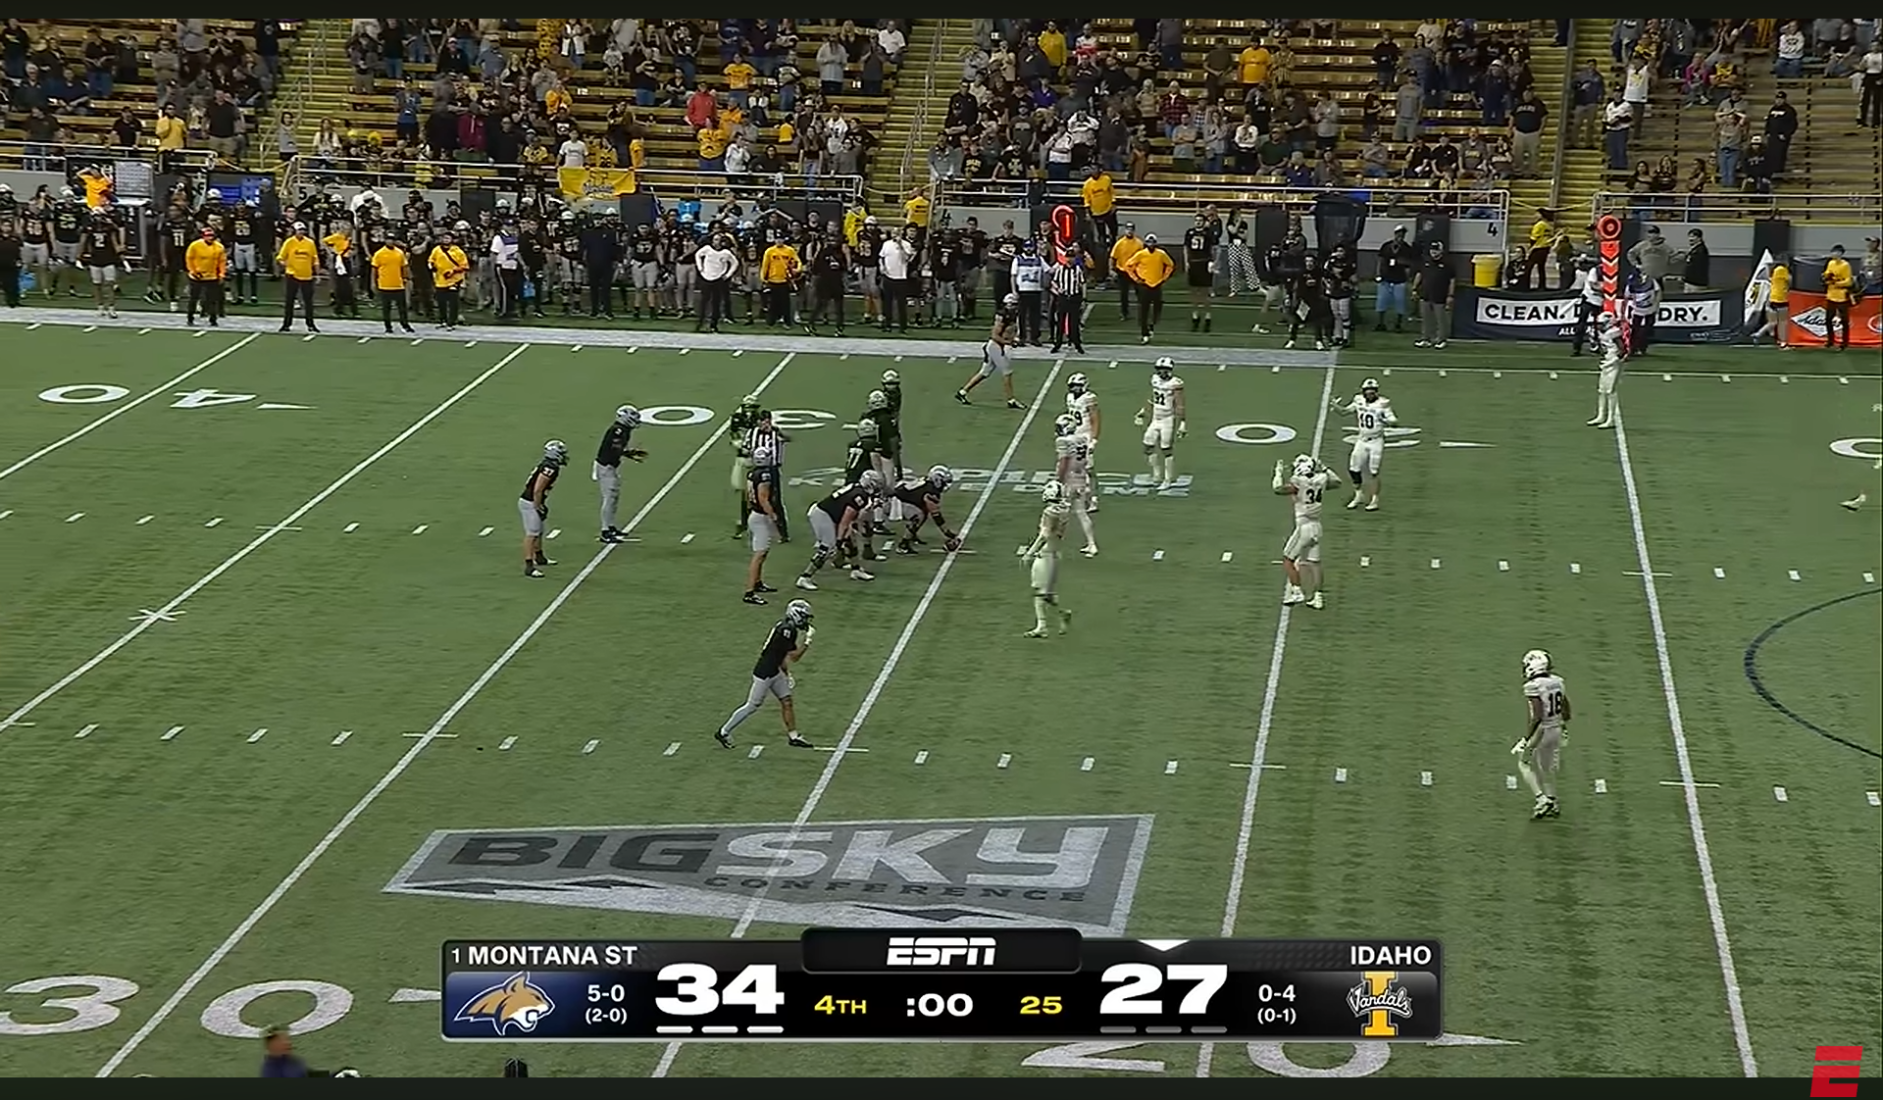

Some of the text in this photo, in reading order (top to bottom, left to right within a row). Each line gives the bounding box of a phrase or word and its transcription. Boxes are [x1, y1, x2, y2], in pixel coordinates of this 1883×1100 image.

[1487, 223, 1498, 237] 4
[1484, 304, 1566, 321] CLEAN.
[703, 875, 1085, 902] CONFERENCE
